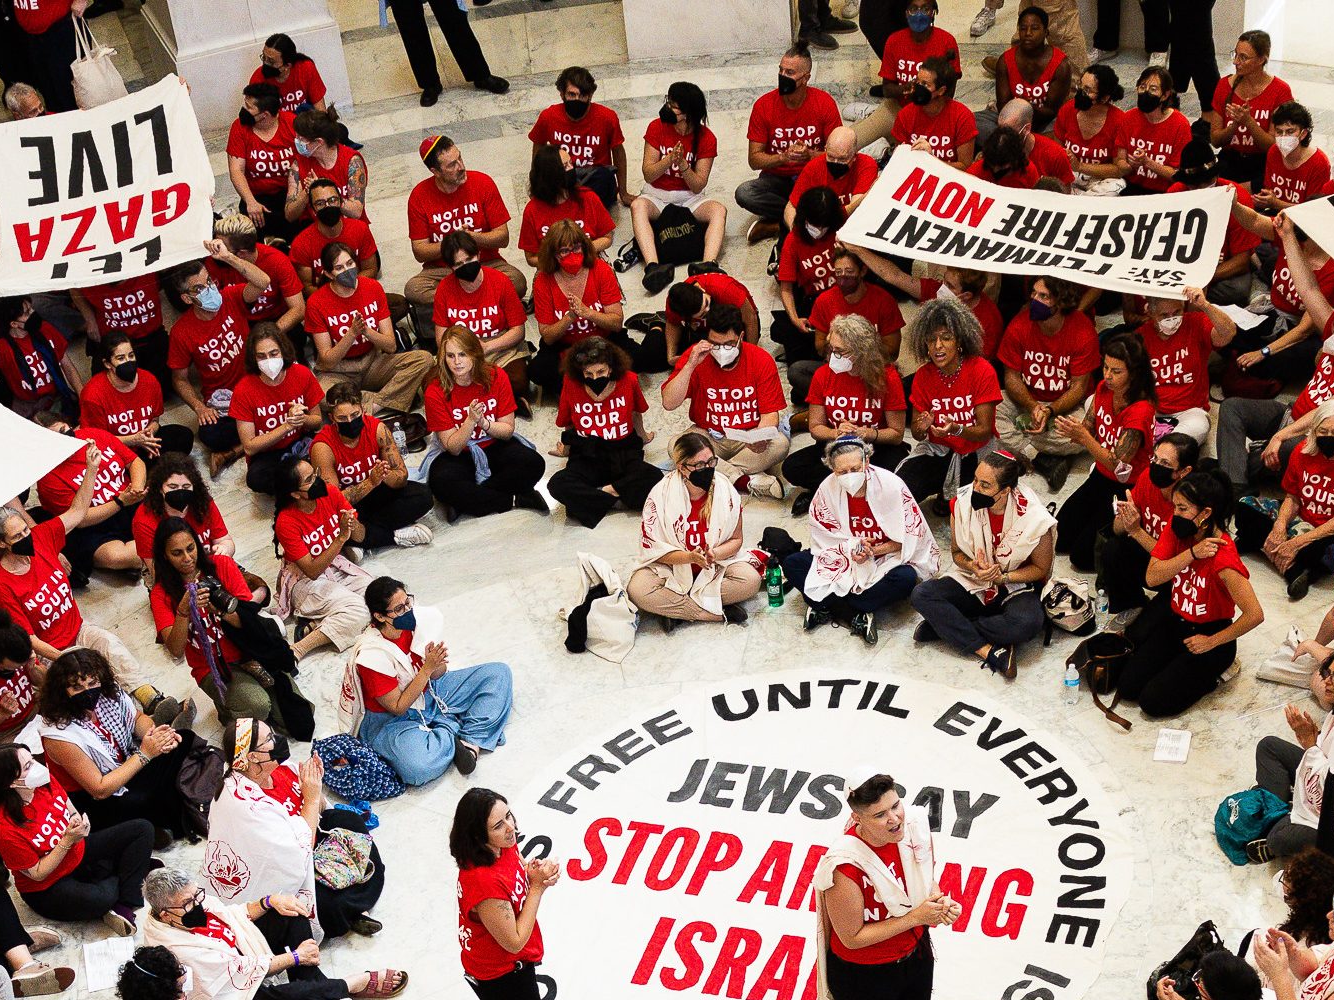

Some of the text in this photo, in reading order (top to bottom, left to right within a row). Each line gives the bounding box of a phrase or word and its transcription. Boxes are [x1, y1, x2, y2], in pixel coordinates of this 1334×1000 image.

[554, 131, 600, 145] NOT IN
[775, 125, 816, 139] STOP
[20, 104, 173, 207] LIVE
[432, 203, 479, 223] NOT IN
[891, 167, 1209, 265] CEASEFIRE NOW
[13, 183, 191, 262] GAZA
[440, 216, 475, 233] OUR
[103, 290, 145, 310] STOP
[105, 300, 155, 320] ARMING
[447, 305, 498, 319] NOT IN
[221, 315, 235, 332] IN
[208, 334, 244, 371] NAME
[209, 330, 236, 360] OUR
[1024, 350, 1070, 367] NOT IN
[1029, 363, 1066, 380] OUR
[707, 386, 754, 400] STOP
[825, 395, 881, 409] NOT IN
[574, 396, 626, 414] NOT IN
[707, 399, 758, 413] ARMING
[107, 405, 153, 424] NOT IN
[580, 411, 620, 429] OUR
[706, 411, 760, 428] ISRAEL
[833, 409, 873, 423] OUR
[1303, 470, 1331, 488] NOT
[24, 583, 50, 611] NOT
[41, 582, 69, 616] OUR
[667, 758, 1000, 838] JEWS AY
[539, 709, 694, 814] FREE
[711, 679, 911, 722] UNTIL
[933, 700, 1107, 950] EVERYONE
[566, 817, 743, 896] STOP
